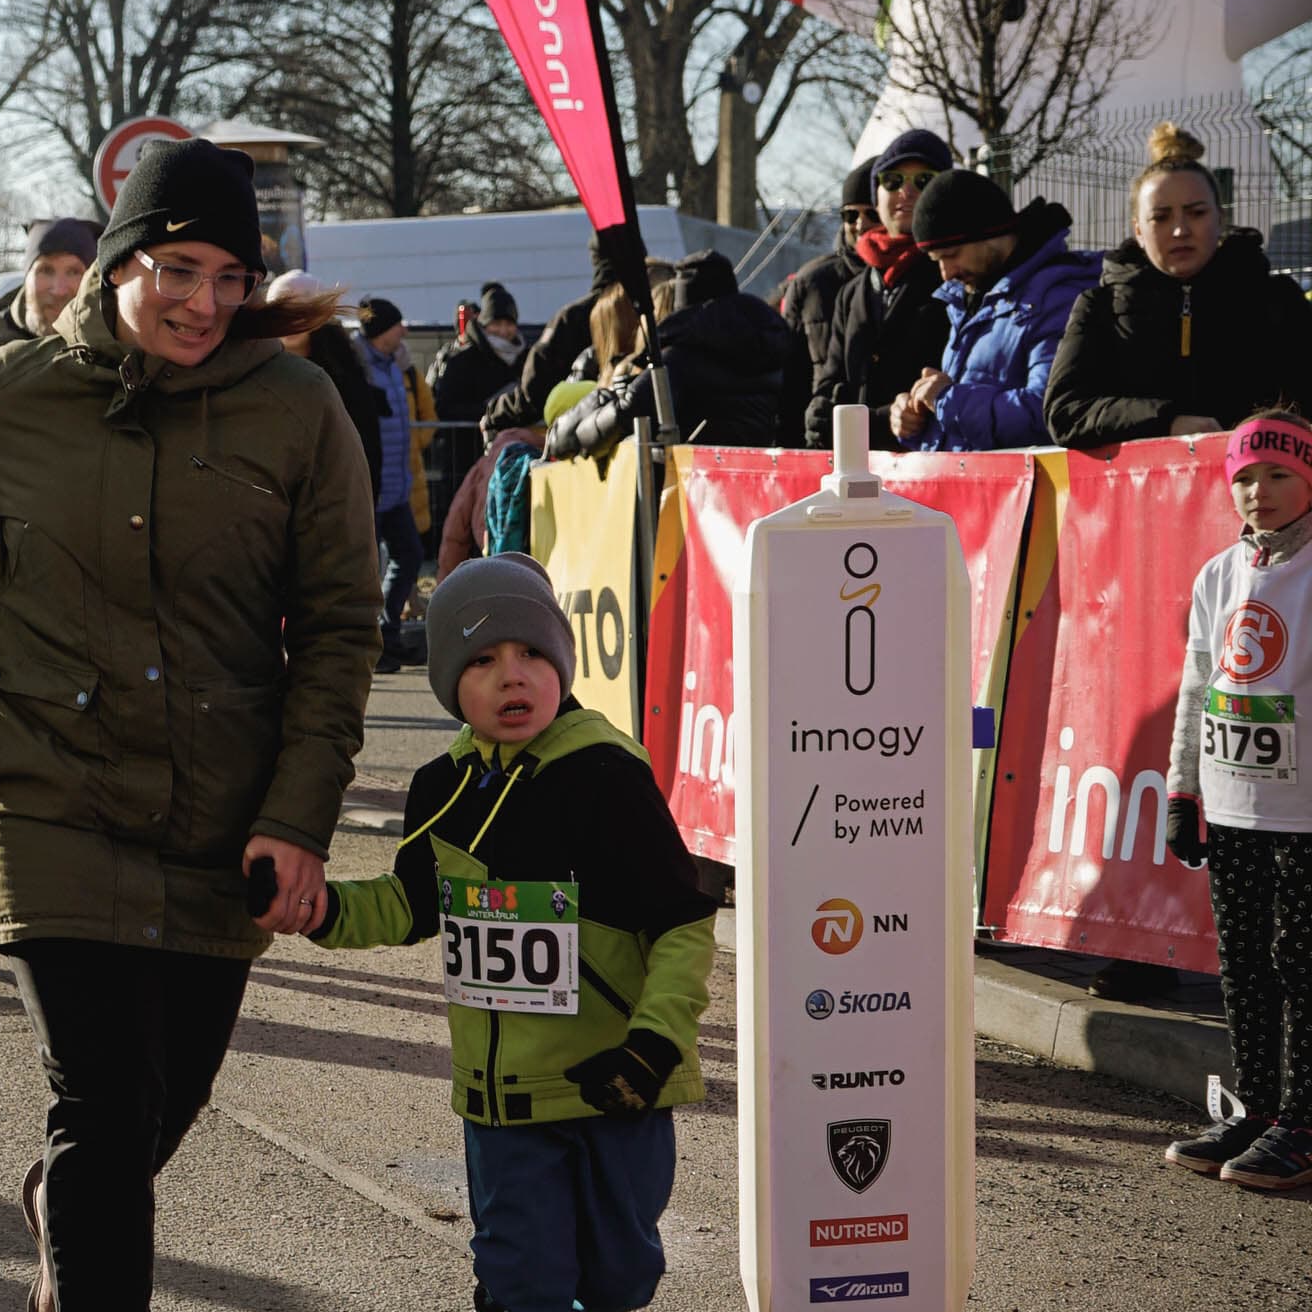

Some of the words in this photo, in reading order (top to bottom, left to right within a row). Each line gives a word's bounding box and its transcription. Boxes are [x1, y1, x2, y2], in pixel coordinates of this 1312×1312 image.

[791, 720, 925, 757] innogy
[1204, 717, 1282, 766] 3179
[834, 789, 925, 813] Powered
[834, 819, 861, 844] by
[869, 816, 924, 837] MVM
[873, 913, 909, 934] NN
[444, 919, 560, 986] 3150
[838, 991, 912, 1014] ŠKODA
[830, 1069, 906, 1089] RUNTO
[833, 1124, 886, 1135] PEUGEOT
[815, 1220, 904, 1241] NUTREND
